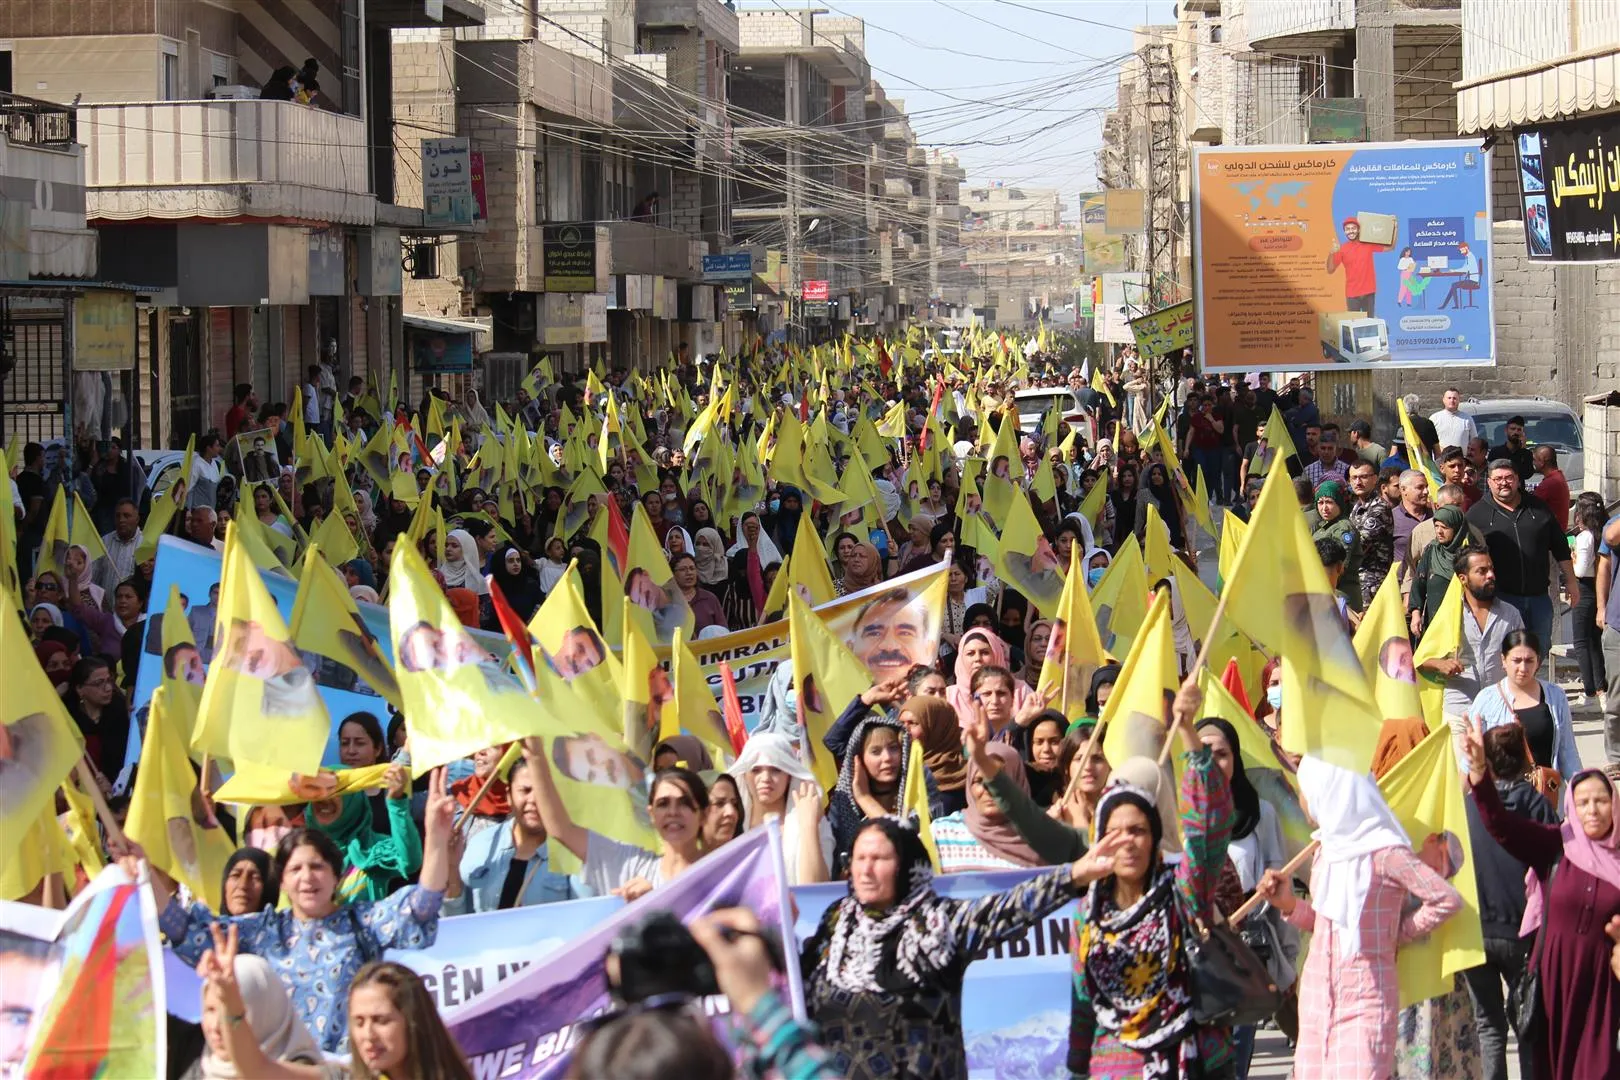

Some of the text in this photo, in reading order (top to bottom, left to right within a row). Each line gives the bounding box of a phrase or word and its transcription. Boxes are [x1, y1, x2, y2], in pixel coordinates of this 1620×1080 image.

[1224, 159, 1336, 171] كارماكس للشحن الدولي
[1349, 162, 1457, 174] كارماكس للمعاملات القانونية
[700, 638, 791, 666] IMRAL
